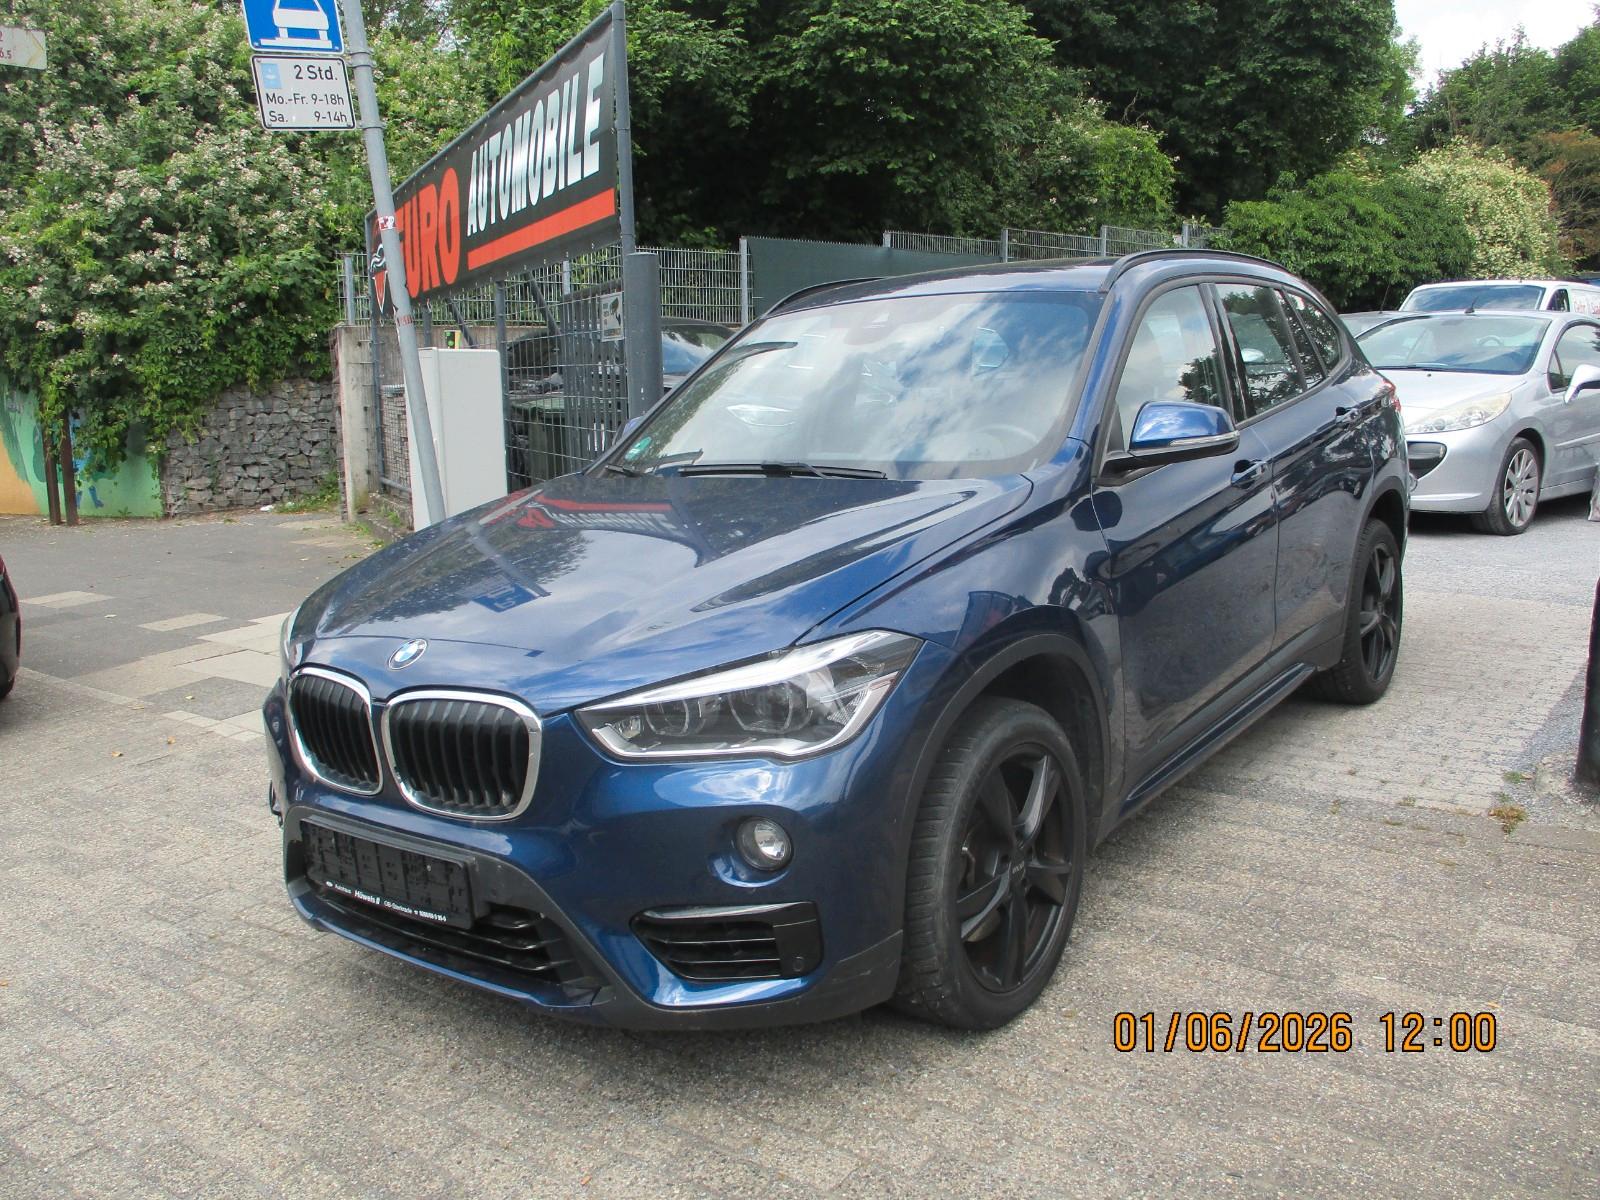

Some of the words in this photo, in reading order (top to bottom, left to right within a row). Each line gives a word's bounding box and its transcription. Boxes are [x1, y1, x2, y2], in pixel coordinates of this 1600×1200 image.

[294, 64, 303, 80] 2
[307, 65, 338, 81] Std.
[266, 92, 309, 105] Mo.-Fr.
[311, 93, 345, 106] 9-18h
[269, 110, 288, 122] Sa.
[314, 111, 348, 123] 9-14h
[467, 53, 604, 237] AUTOMOBILE
